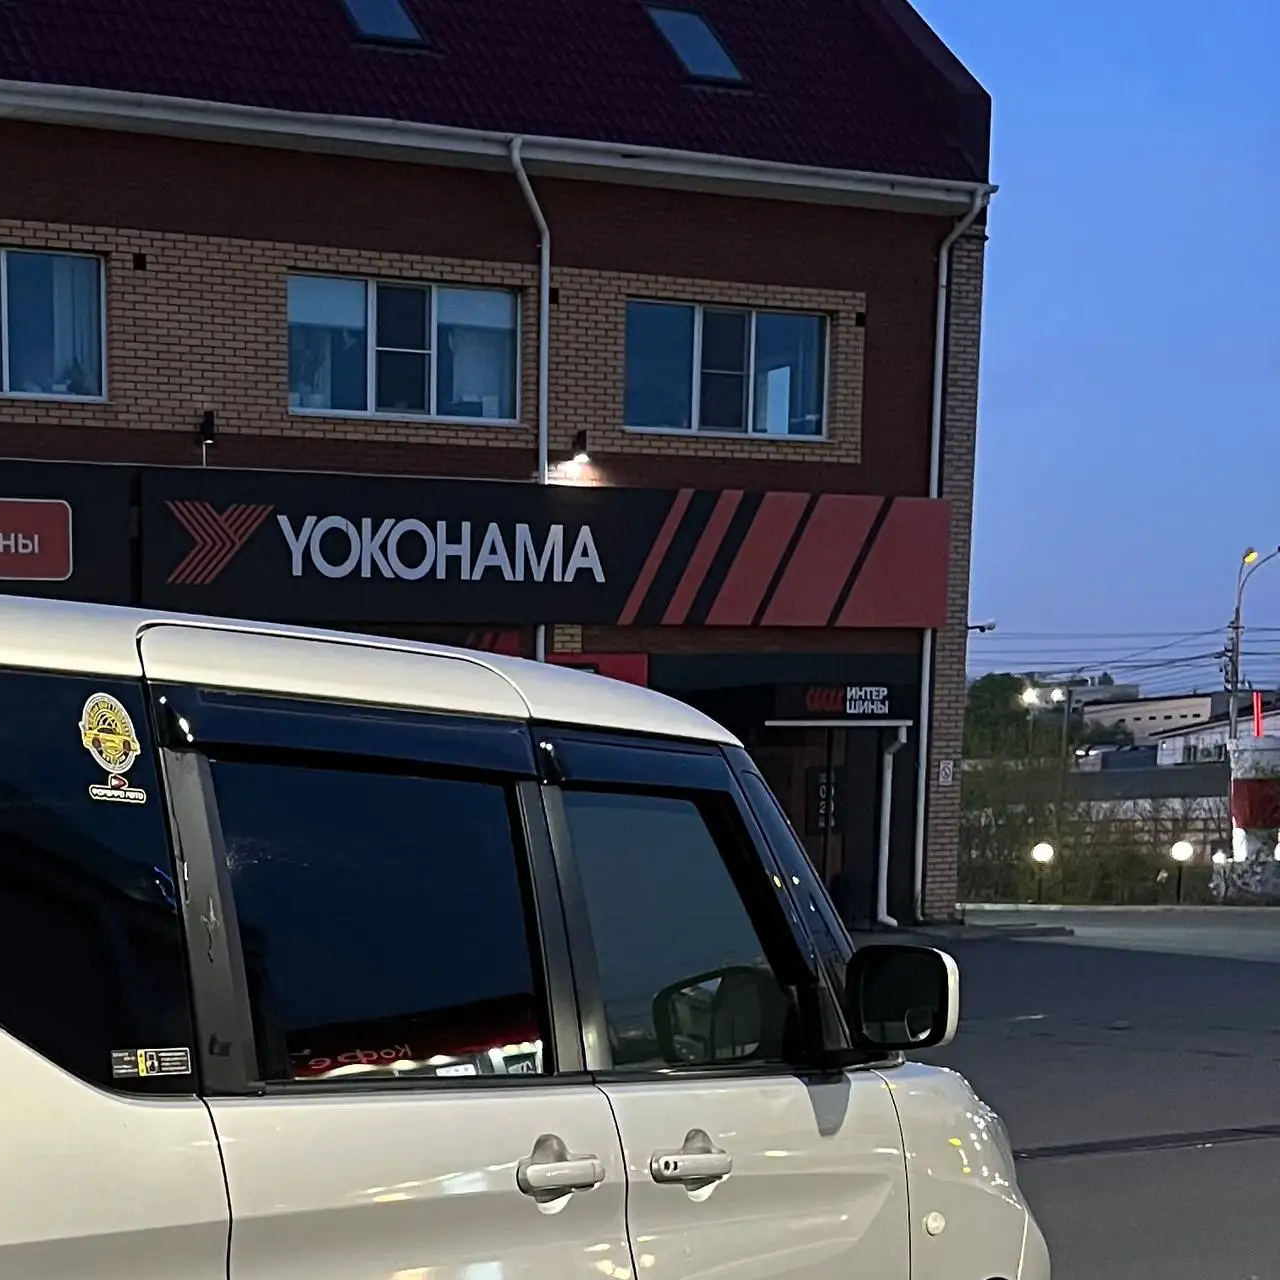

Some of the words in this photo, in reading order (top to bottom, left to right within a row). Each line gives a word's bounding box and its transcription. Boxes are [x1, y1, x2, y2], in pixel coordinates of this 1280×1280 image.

[276, 513, 606, 584] YOKOHAMA
[846, 686, 888, 700] ИНТЕР
[846, 700, 889, 714] ШИНЫ
